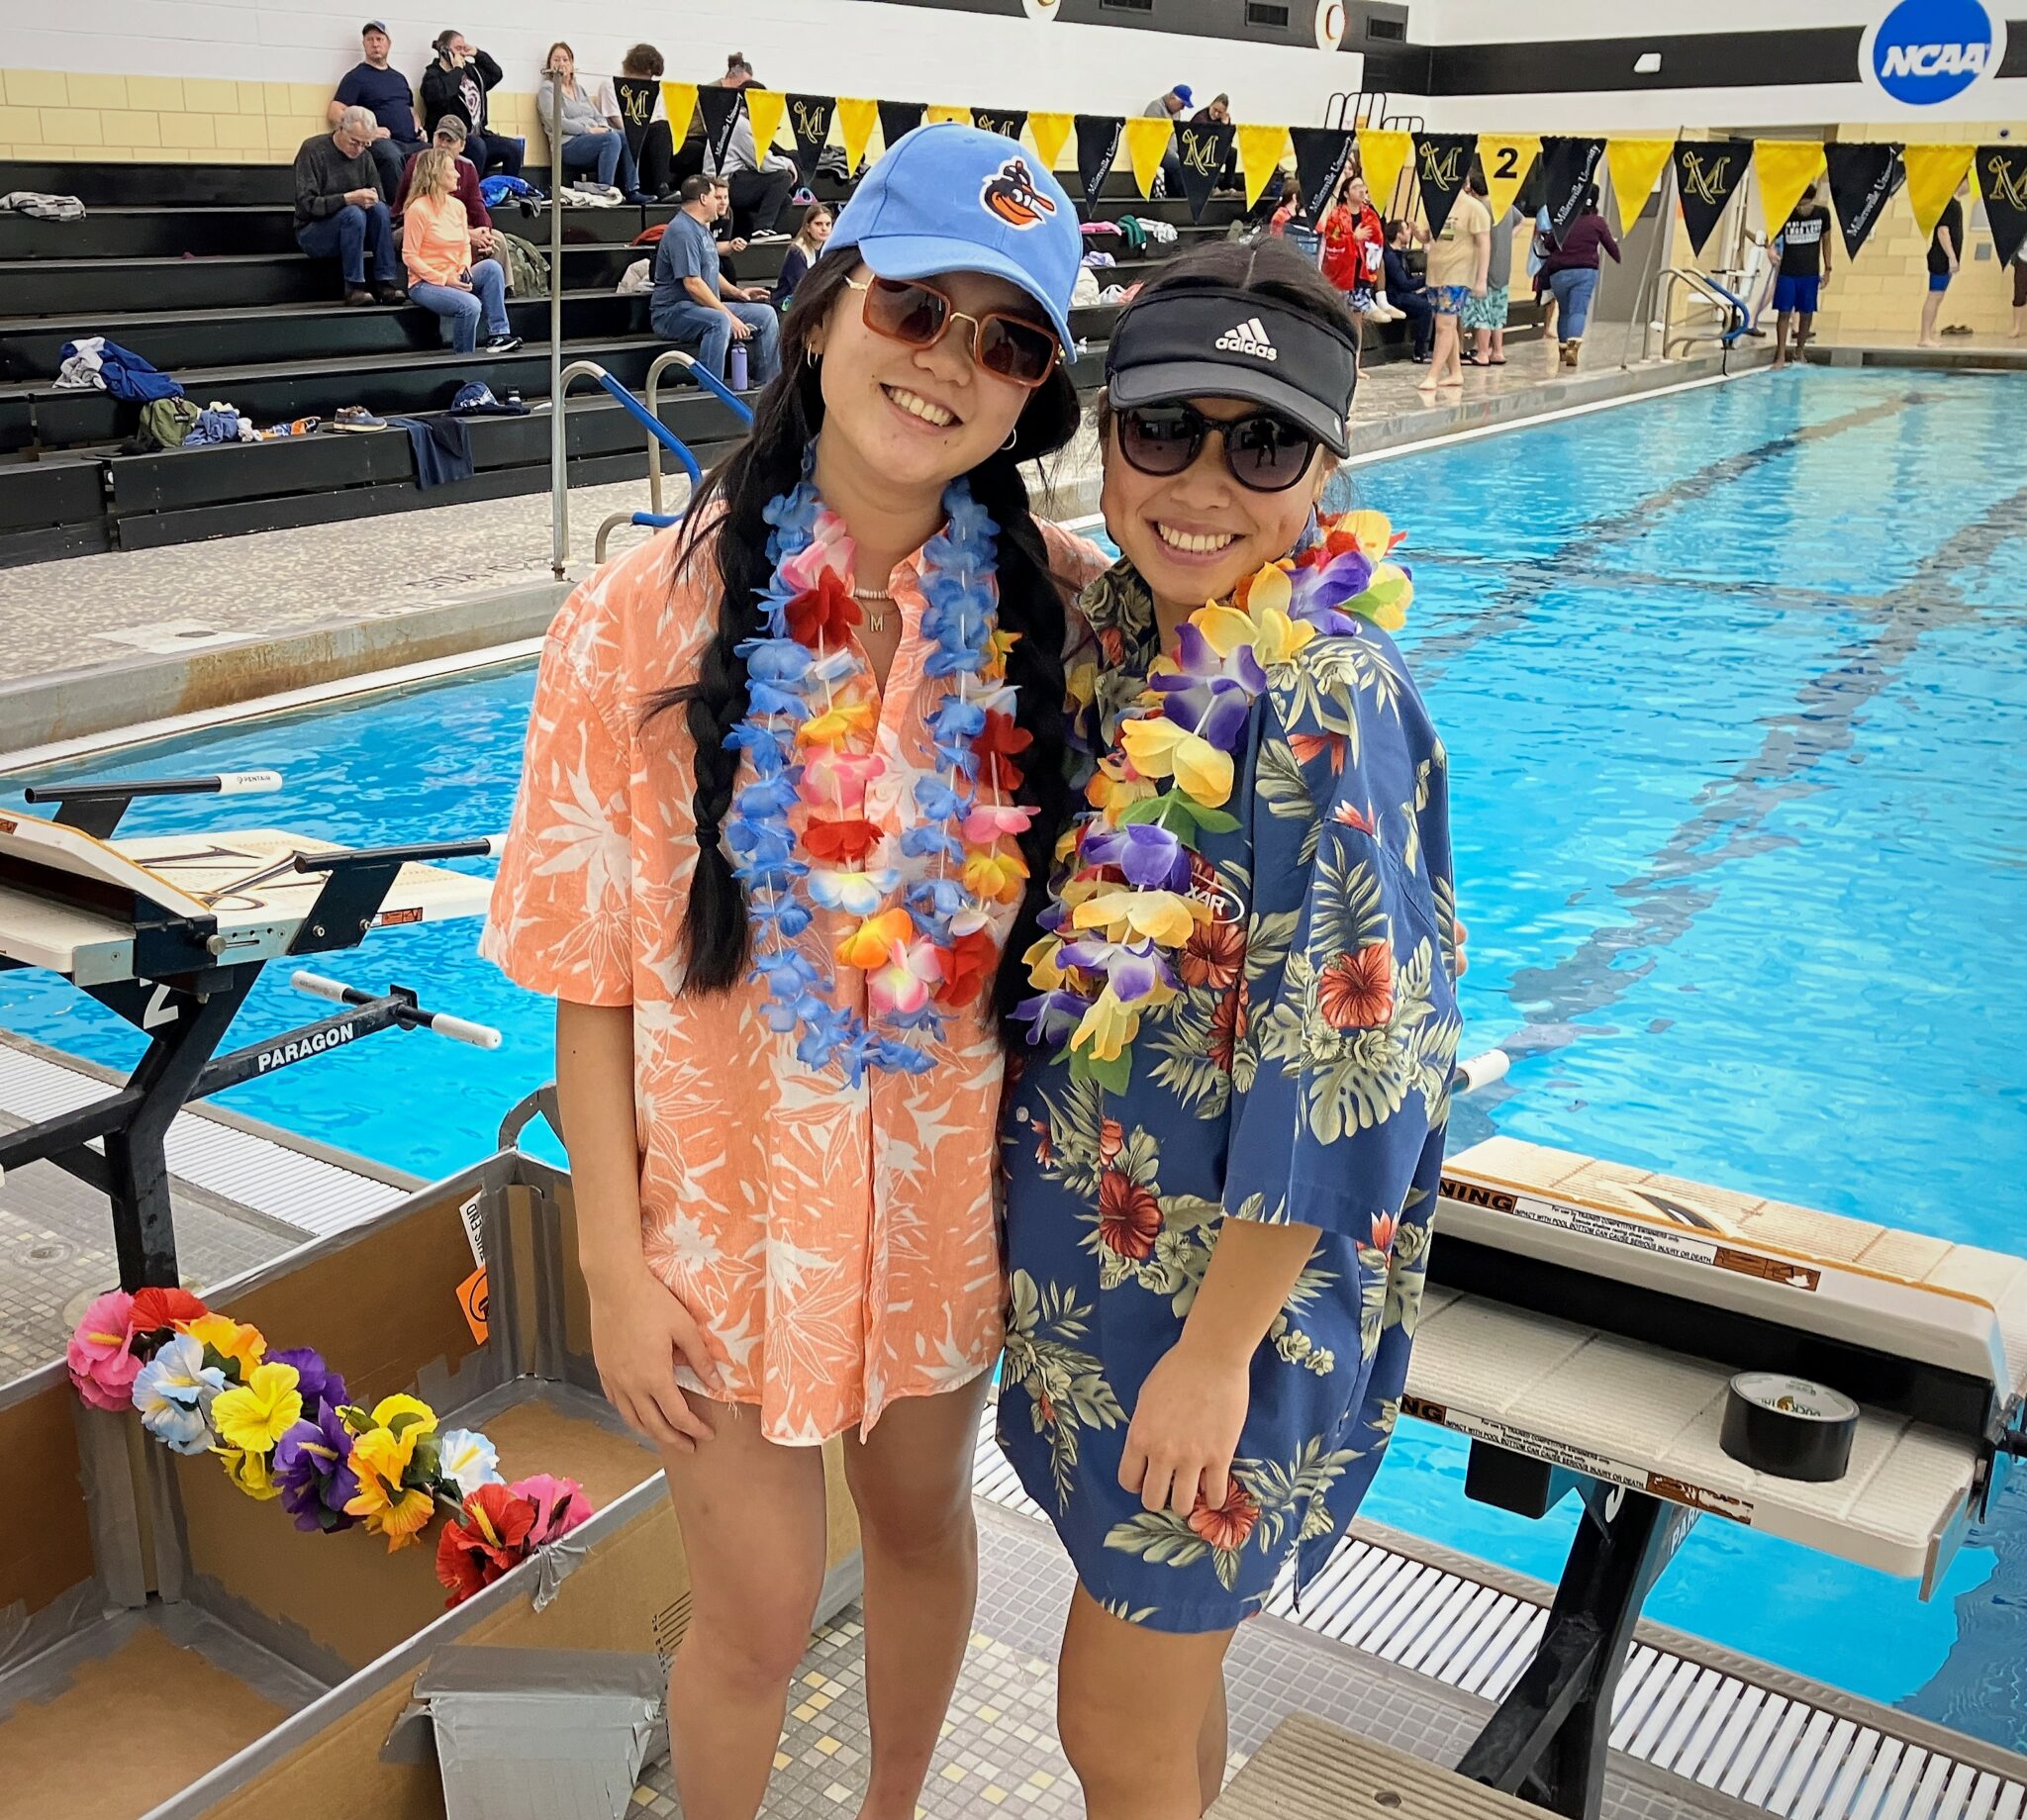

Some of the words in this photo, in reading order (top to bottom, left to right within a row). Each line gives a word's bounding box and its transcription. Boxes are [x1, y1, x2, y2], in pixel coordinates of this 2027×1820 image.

[1882, 43, 1985, 77] NCAA
[1494, 147, 1518, 178] 2
[1554, 183, 1584, 225] Millersville
[1215, 336, 1278, 361] adidas
[871, 615, 884, 632] M
[257, 1022, 354, 1073] PARAGON
[466, 1203, 482, 1232] END
